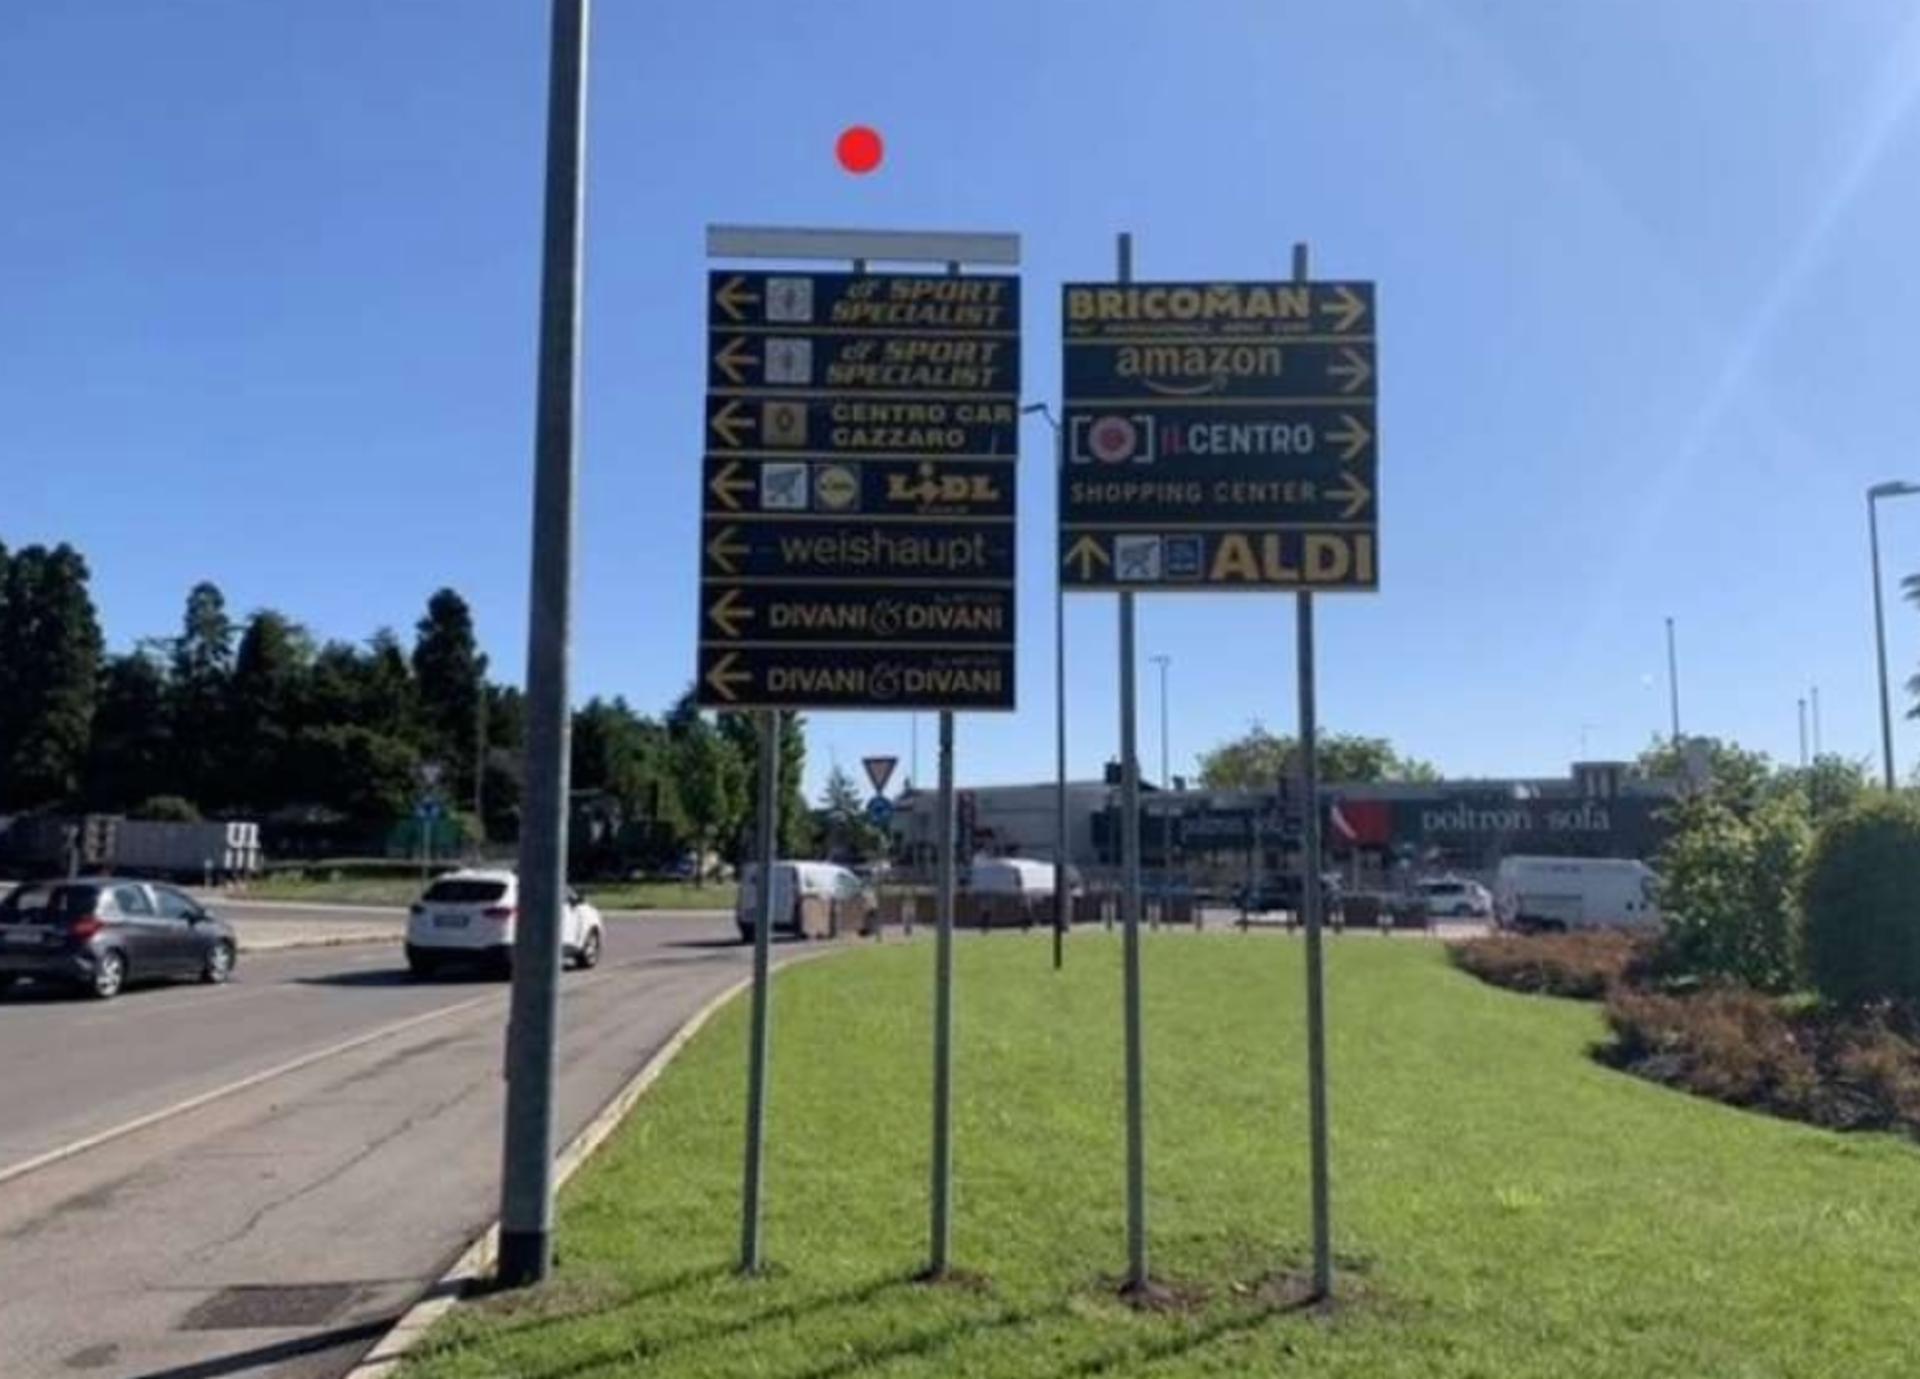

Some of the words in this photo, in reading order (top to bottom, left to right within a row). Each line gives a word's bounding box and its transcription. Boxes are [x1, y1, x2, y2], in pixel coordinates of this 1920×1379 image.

[890, 279, 1006, 302] SPORT
[1068, 286, 1311, 319] BRICOMAN
[831, 299, 1005, 327] SPECIALIST
[884, 340, 999, 364] SPORT
[1115, 344, 1283, 377] amazon
[826, 362, 998, 388] SPECIALIST
[832, 403, 946, 424] CENTRO
[956, 404, 1013, 424] CAR
[1070, 481, 1203, 505] SHOPPING
[1213, 481, 1318, 505] CENTER
[779, 529, 987, 570] weishaupt
[1208, 533, 1372, 582] ALDI
